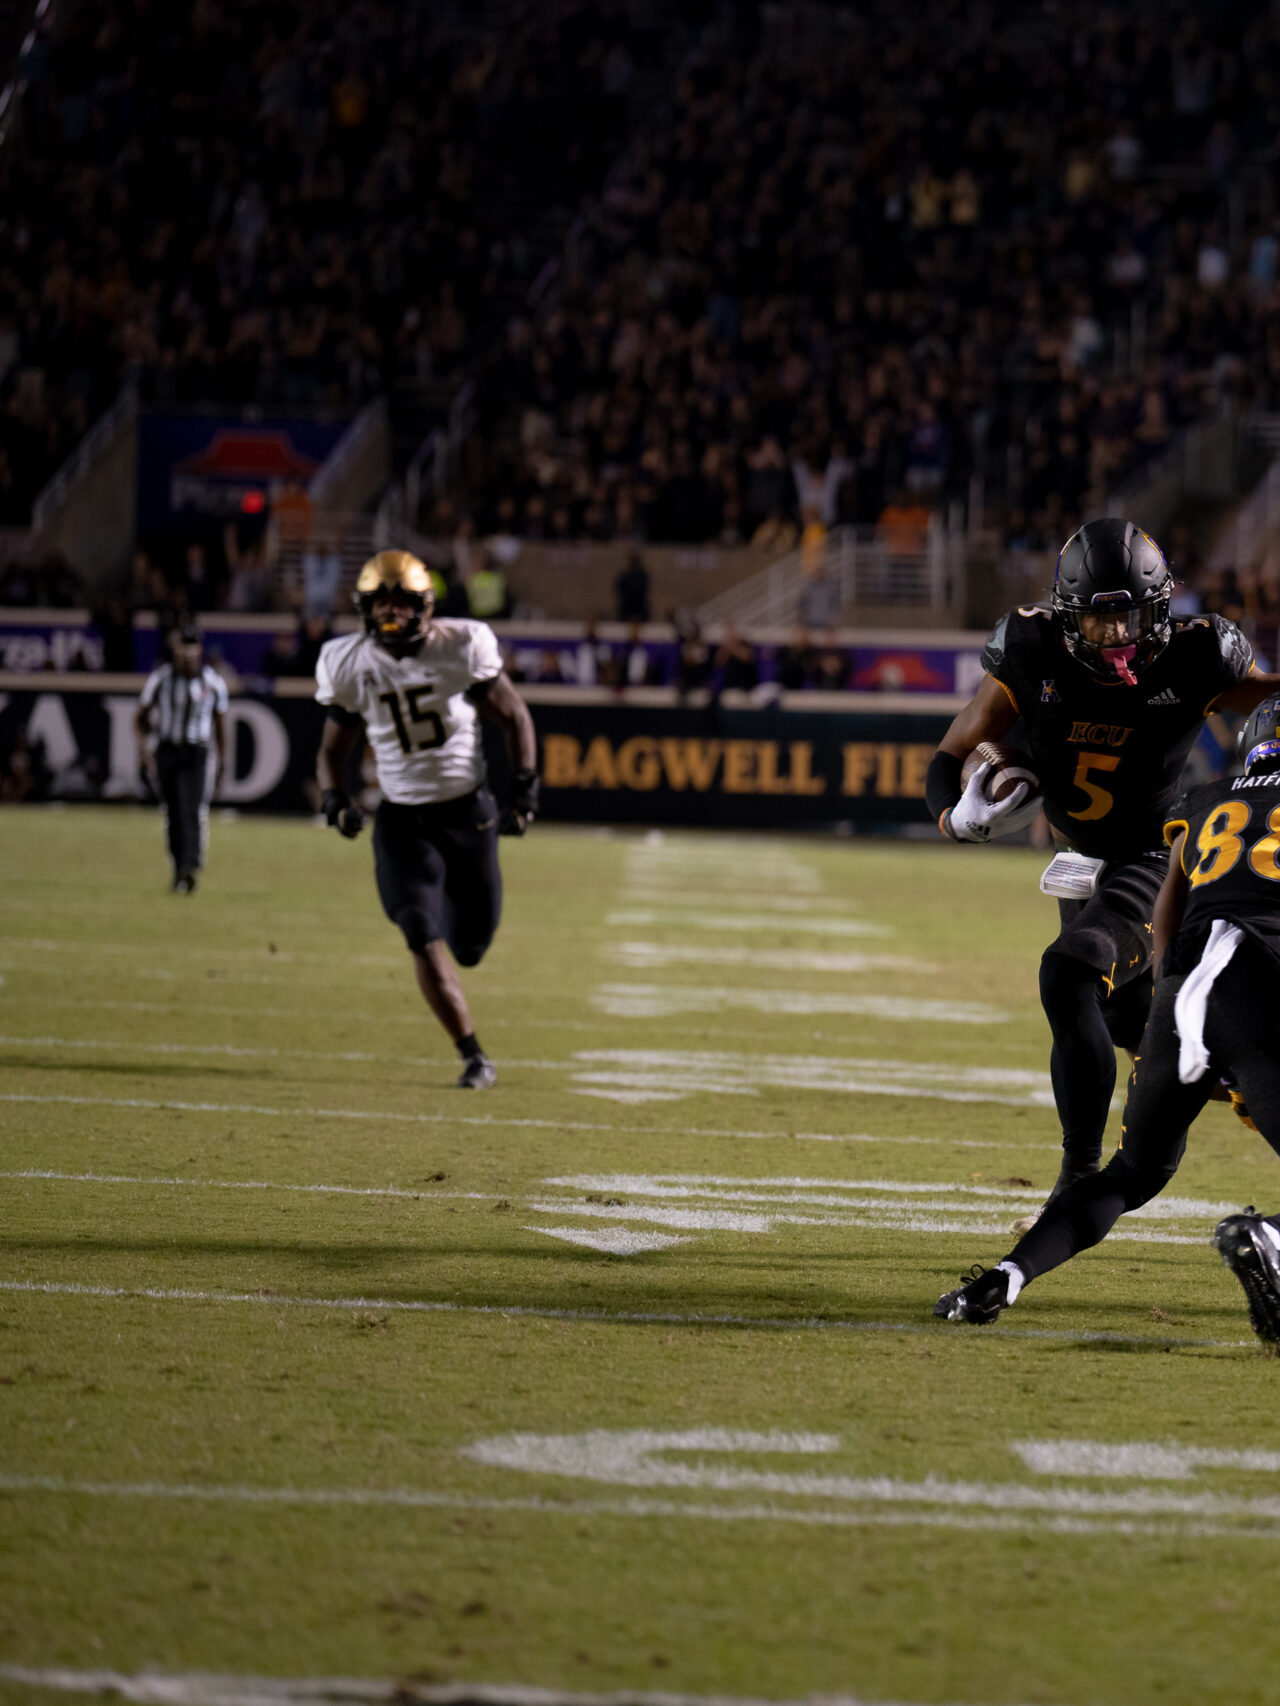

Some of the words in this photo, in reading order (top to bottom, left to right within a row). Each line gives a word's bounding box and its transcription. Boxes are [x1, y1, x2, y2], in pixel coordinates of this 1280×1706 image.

[379, 684, 446, 754] 15
[1066, 720, 1134, 747] ECU
[542, 732, 828, 796] BAGWELL
[1066, 750, 1121, 822] 5
